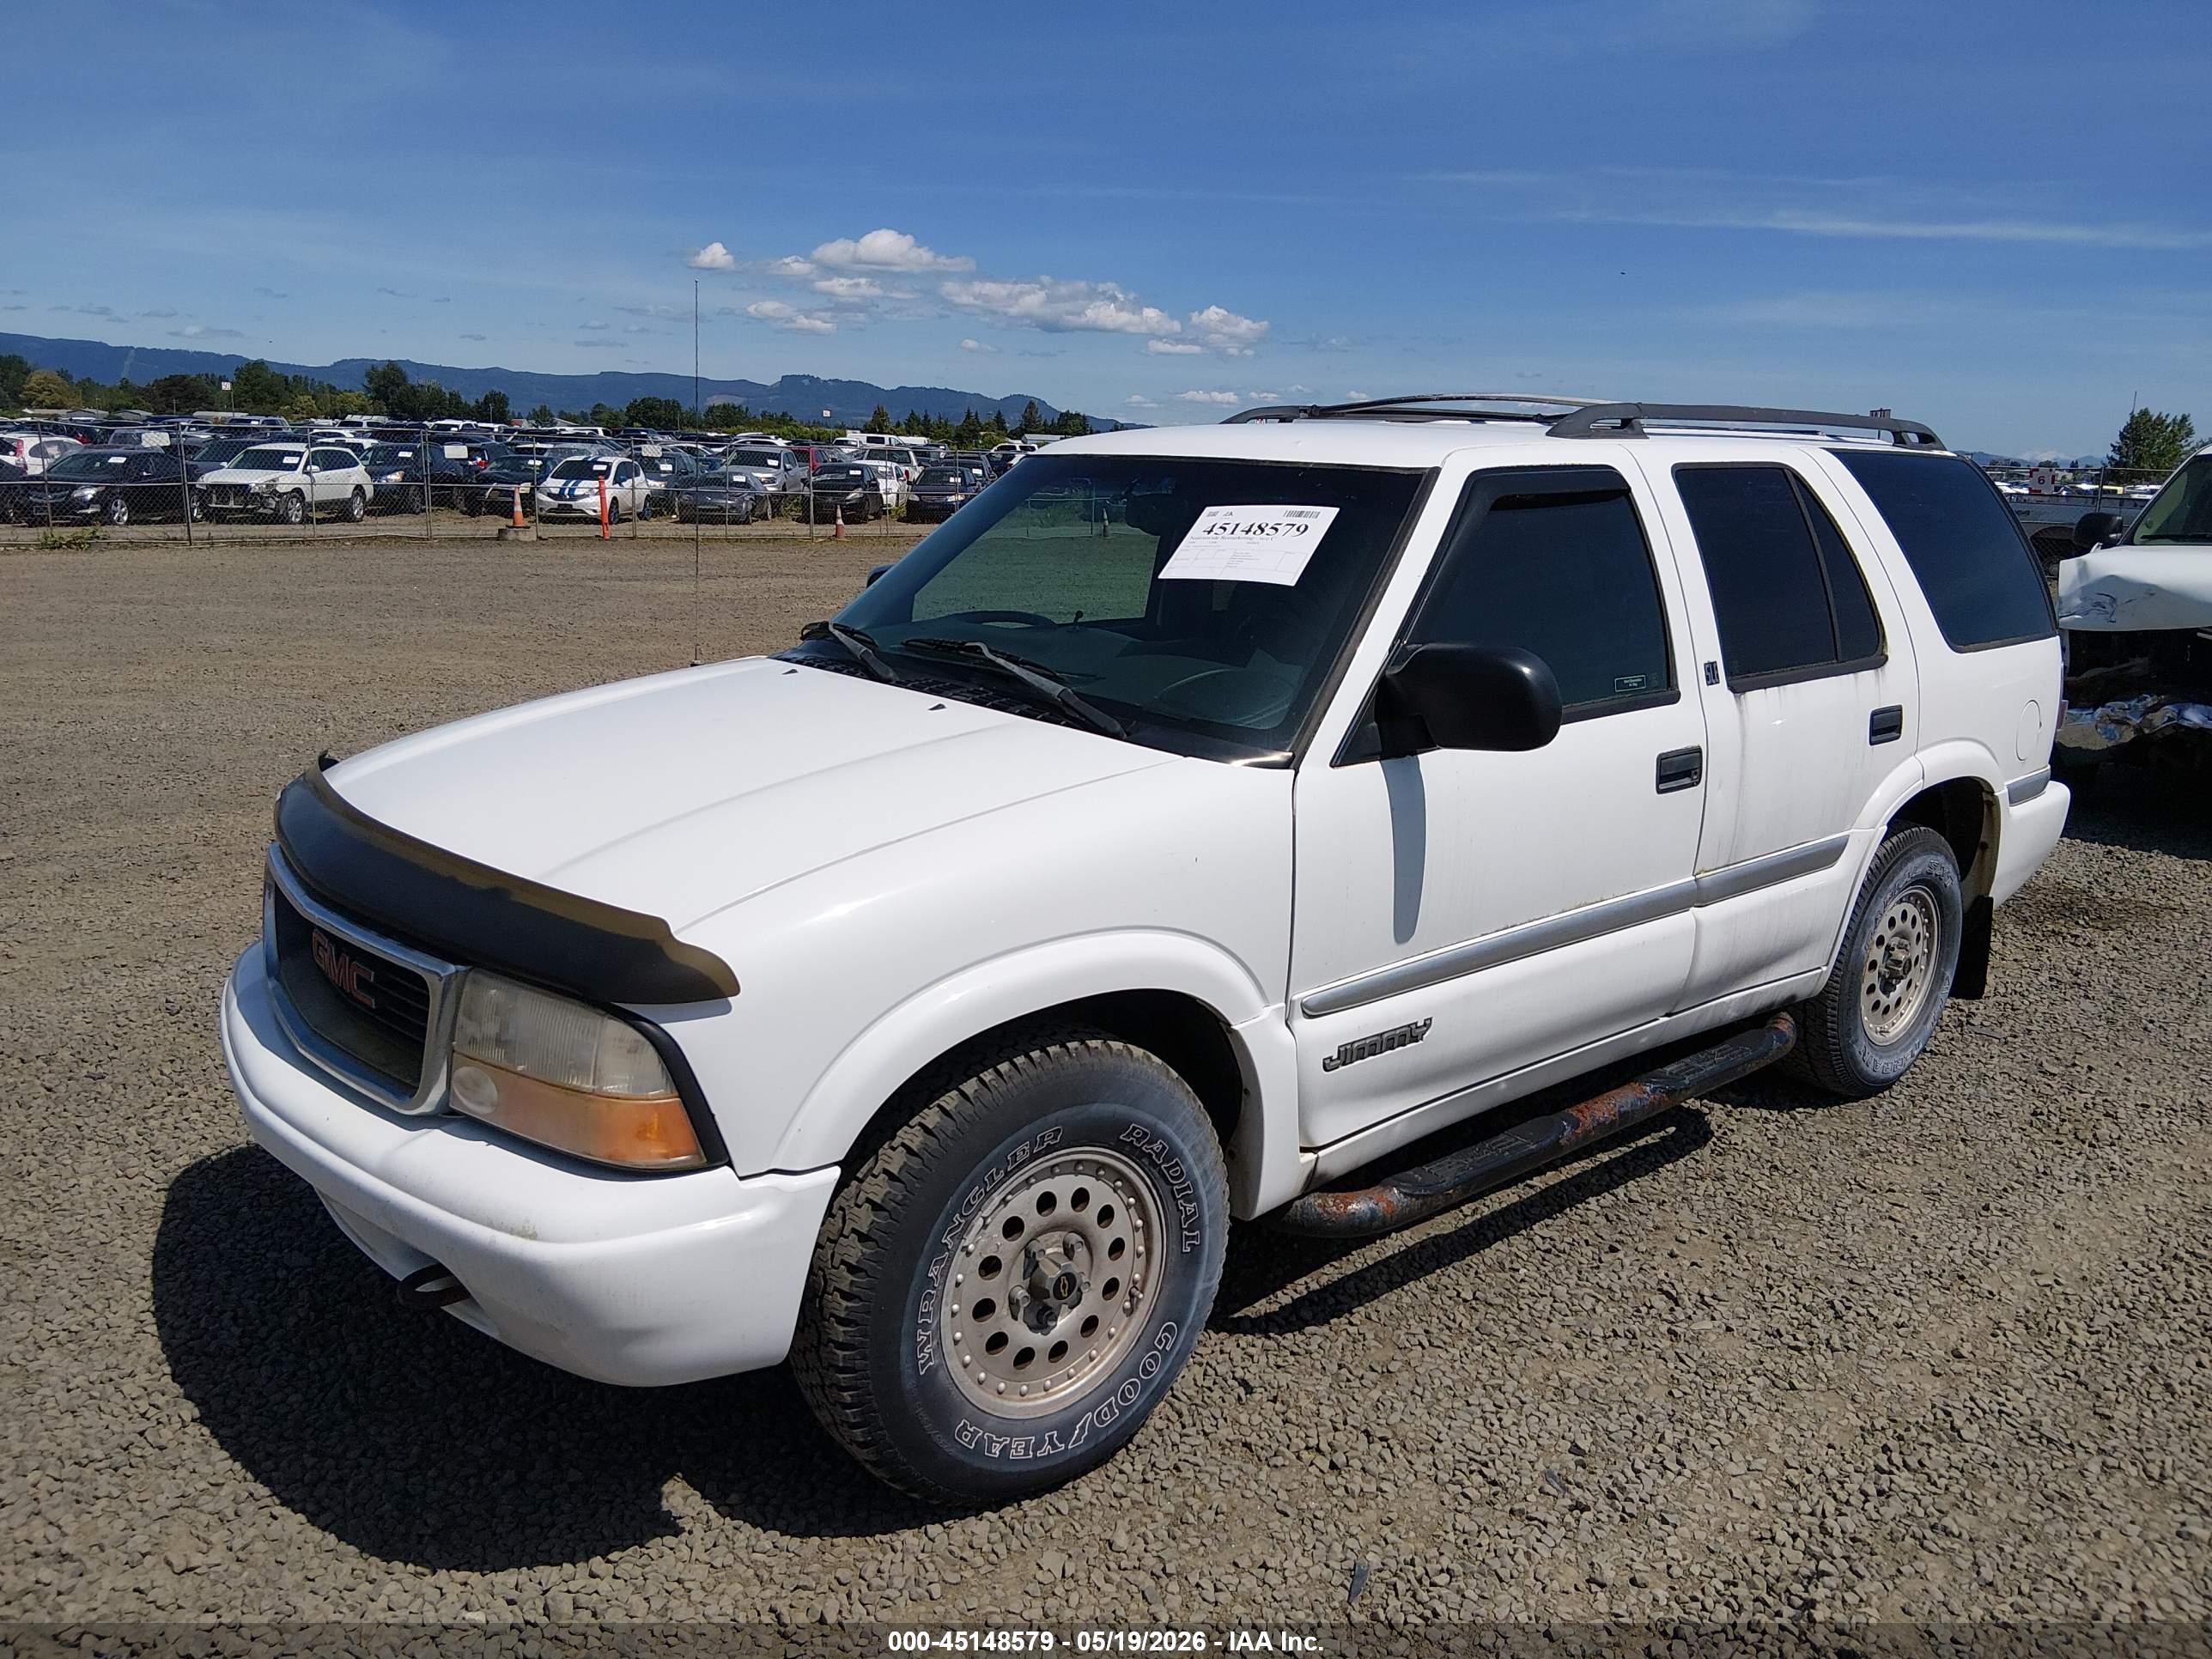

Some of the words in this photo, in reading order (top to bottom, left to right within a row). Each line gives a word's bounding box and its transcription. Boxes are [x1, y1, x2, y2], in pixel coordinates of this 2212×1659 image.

[2037, 475, 2046, 485] 6
[1202, 521, 1310, 538] 45148579
[313, 928, 375, 1009] GMC
[915, 1126, 1064, 1376] WRANGLER
[1119, 1123, 1202, 1254] RADIAL
